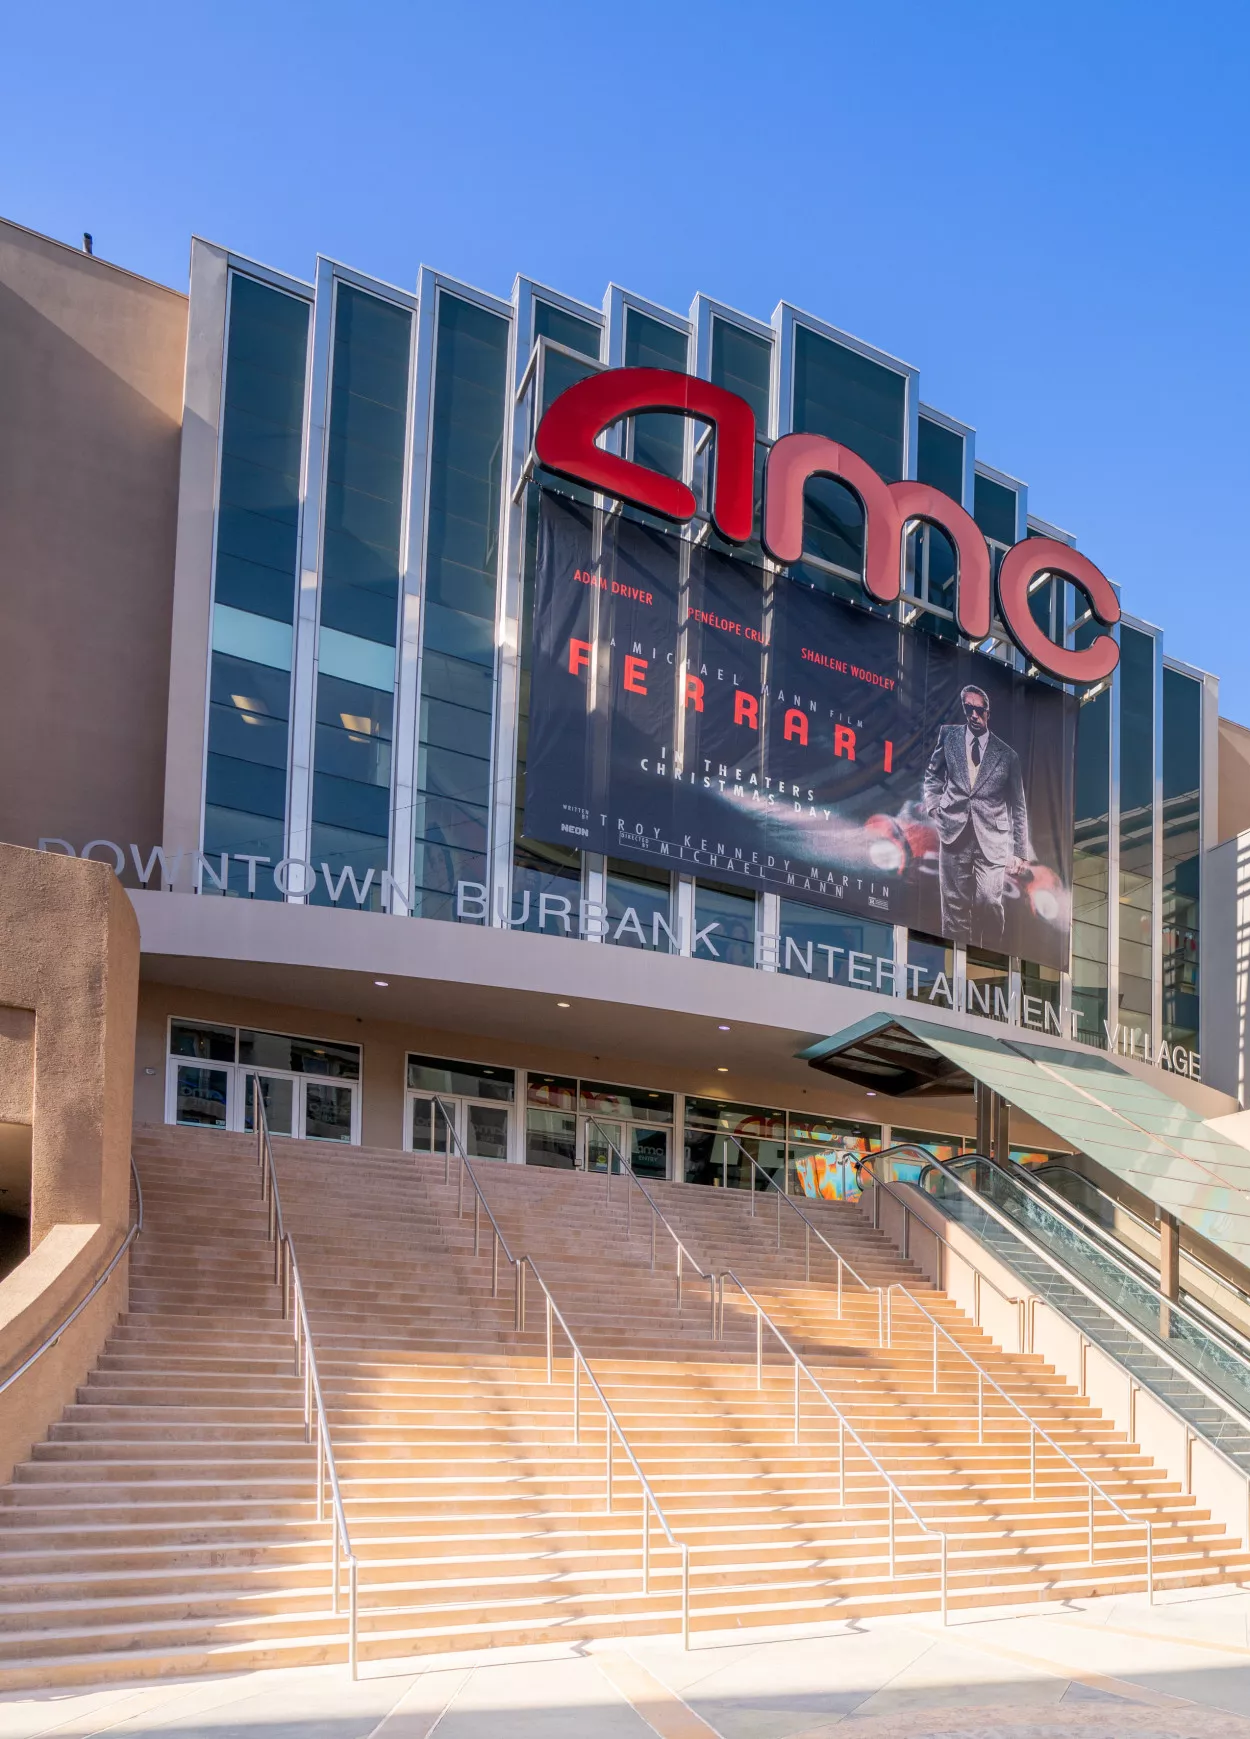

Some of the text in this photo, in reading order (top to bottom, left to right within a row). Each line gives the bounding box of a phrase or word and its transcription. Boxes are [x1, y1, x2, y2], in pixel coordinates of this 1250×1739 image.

[533, 366, 1121, 684] amc
[573, 569, 653, 606] ADAM DRIVER
[687, 607, 741, 635] PENÉLOPE
[609, 637, 863, 728] A MICHAEL MANN FILM
[801, 648, 895, 691] SHAILENE WOODLEY
[568, 637, 893, 774] FERRARI
[640, 758, 831, 821] CHRISTMAS DAY
[661, 746, 814, 802] IN THEATERS
[560, 823, 589, 838] NEON
[562, 803, 590, 815] WRITTEN
[600, 814, 889, 898] TROY KENNEDY MARTIN
[661, 842, 843, 898] MICHAEL MANN
[457, 880, 720, 956] BURBANK
[754, 931, 1084, 1041] ENTERTAINMENT
[1103, 1019, 1202, 1080] VILLAGE
